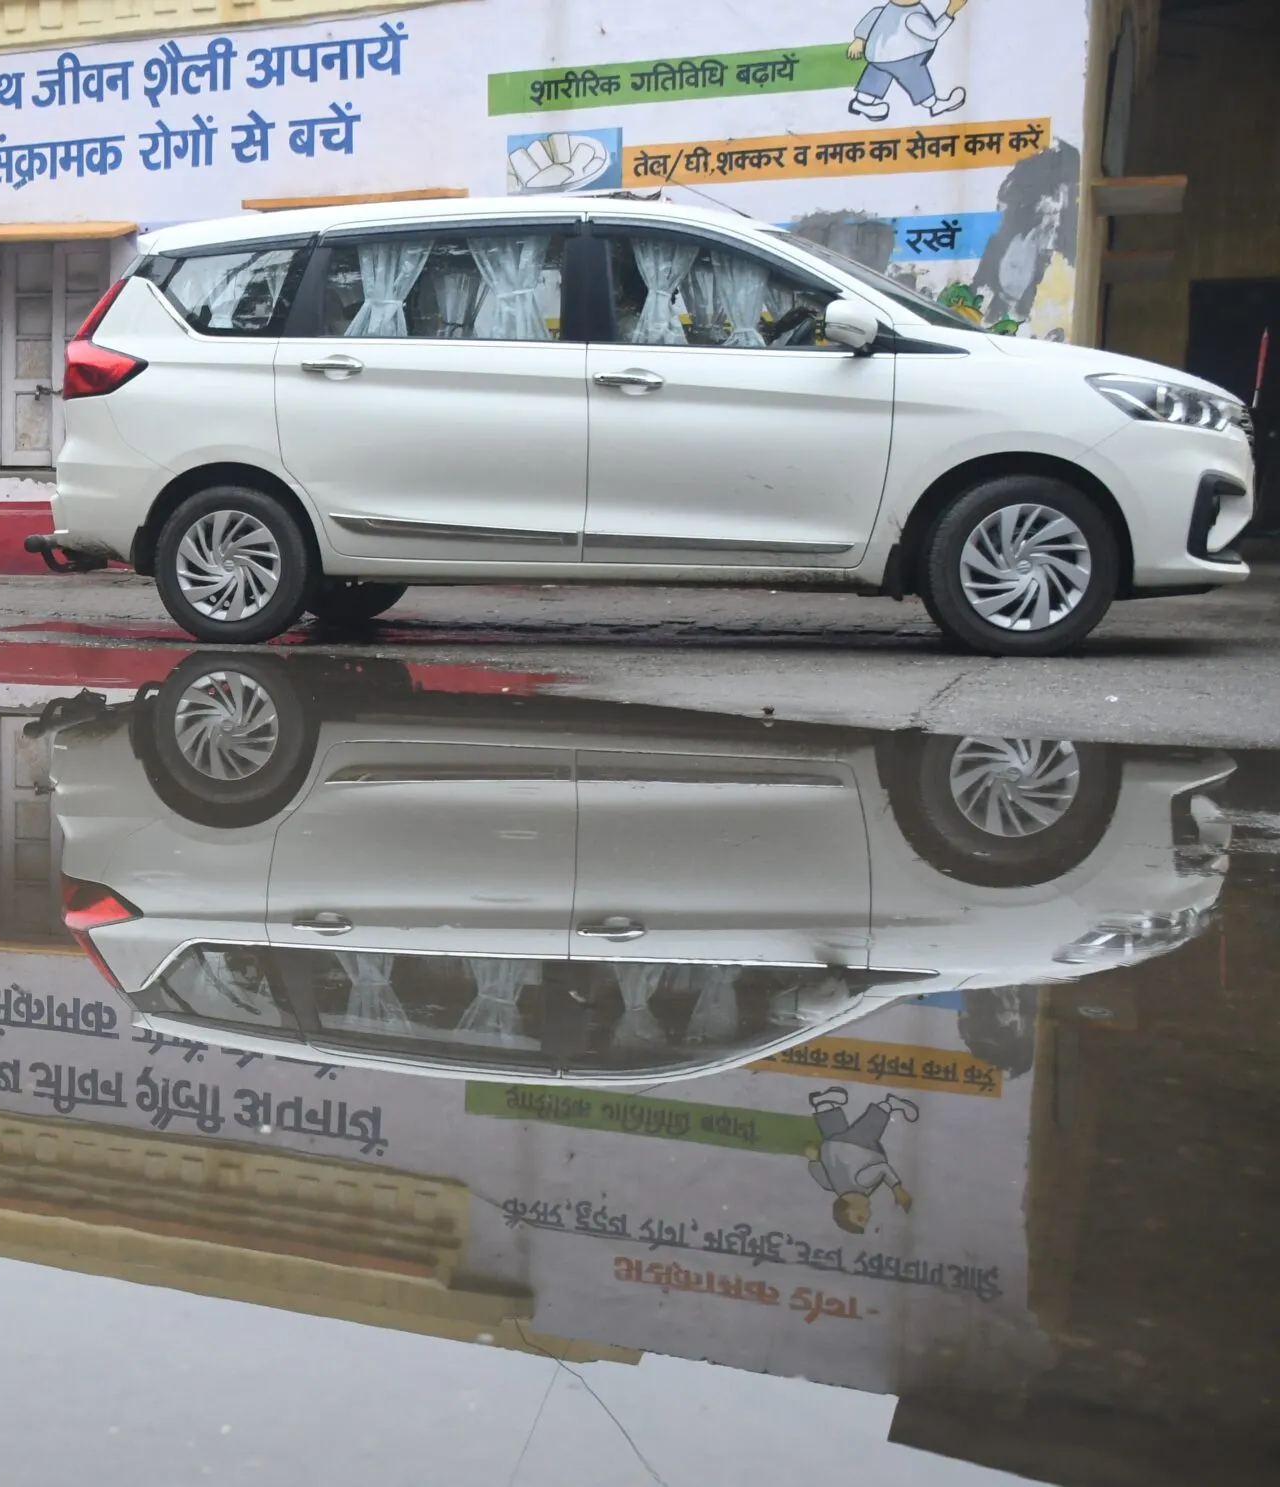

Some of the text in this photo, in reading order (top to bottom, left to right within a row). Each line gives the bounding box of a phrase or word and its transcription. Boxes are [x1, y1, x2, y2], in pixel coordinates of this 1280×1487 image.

[32, 52, 135, 109] जीवन
[144, 37, 237, 107] शैली
[246, 21, 409, 89] अपनायें
[530, 53, 800, 105] शारीरिक गतिविधि बढ़ायें
[139, 115, 218, 170] रोगों
[231, 111, 275, 163] से
[289, 102, 361, 157] बचें
[793, 145, 810, 167] व
[815, 143, 865, 166] नमक
[869, 139, 900, 163] का
[906, 130, 959, 160] सेवन
[964, 132, 1004, 156] कम
[1008, 124, 1044, 153] करें
[906, 219, 962, 254] रखें
